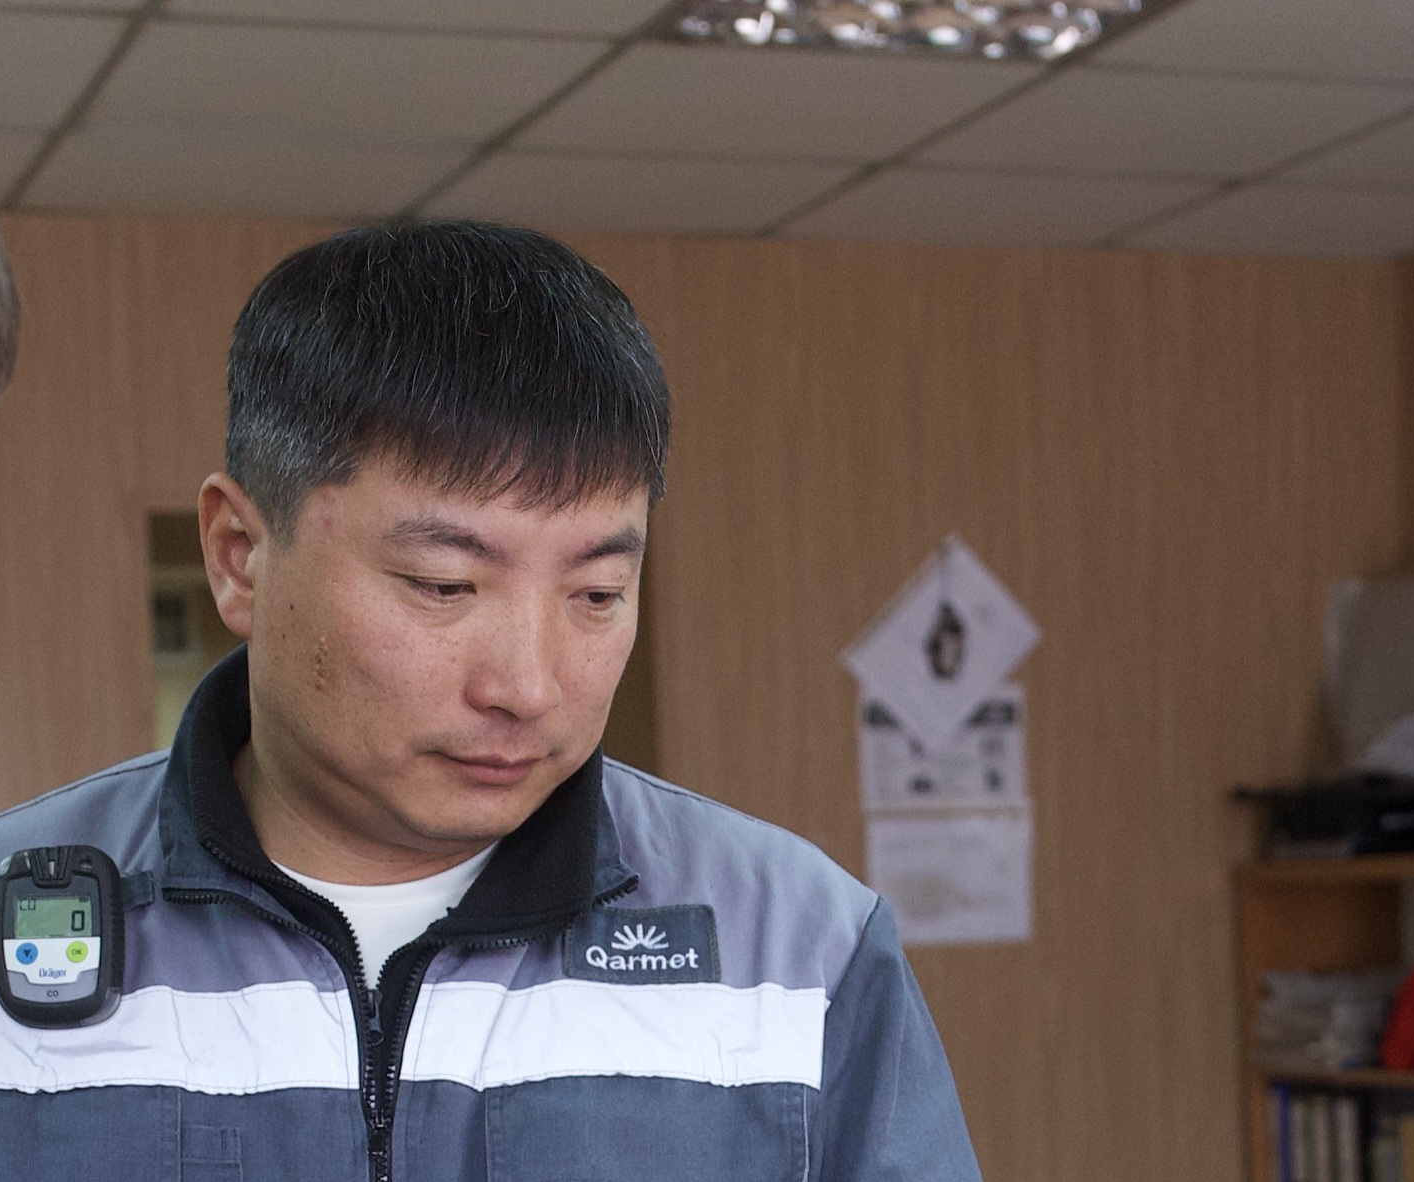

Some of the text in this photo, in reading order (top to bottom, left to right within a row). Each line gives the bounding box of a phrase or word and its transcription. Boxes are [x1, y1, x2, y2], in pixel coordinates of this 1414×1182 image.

[71, 910, 85, 931] 0
[71, 948, 82, 956] OK
[585, 945, 699, 971] Qarmet
[39, 968, 67, 979] Dräger
